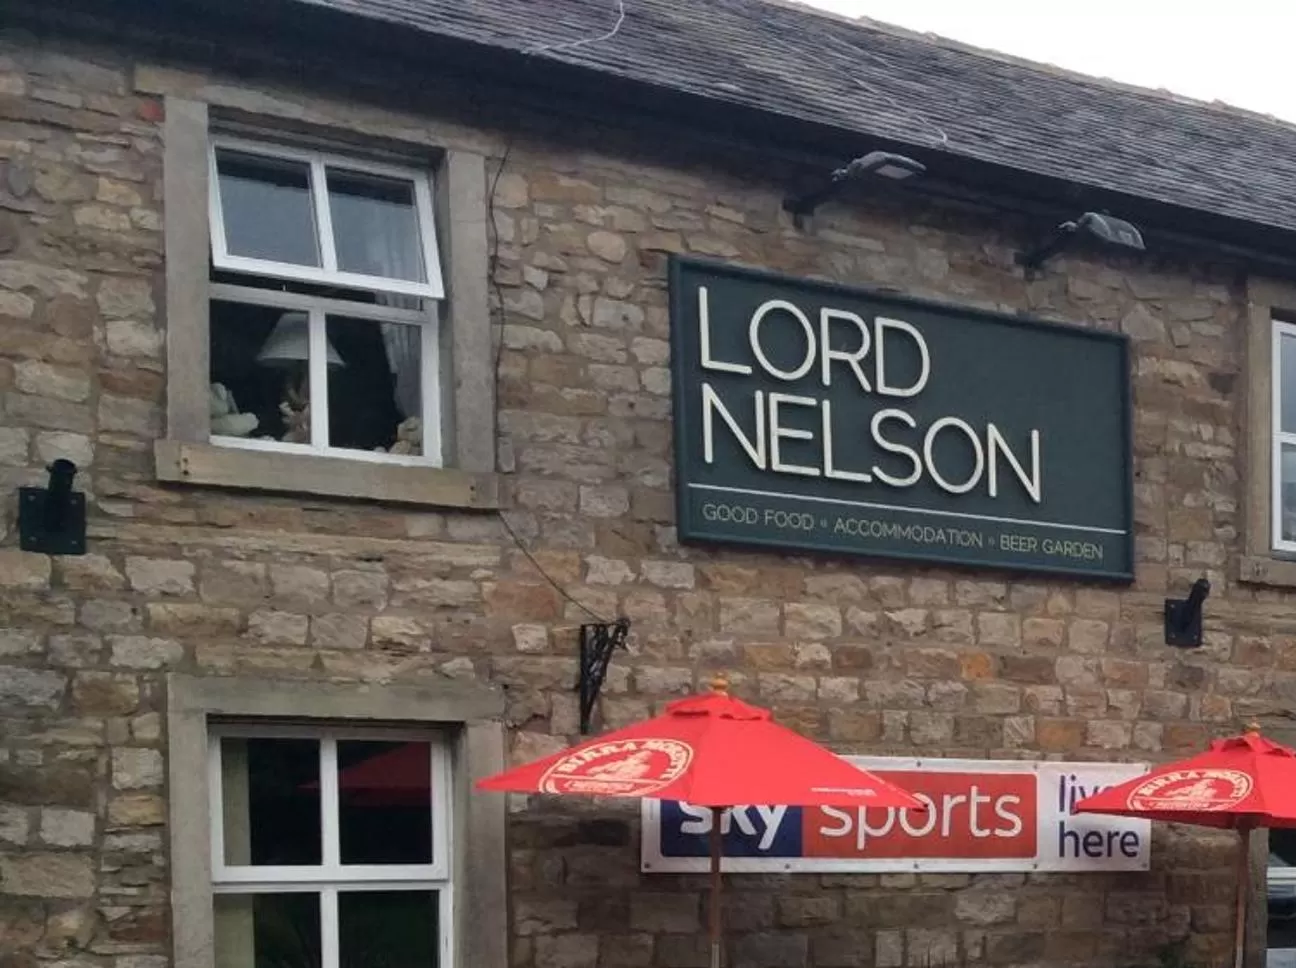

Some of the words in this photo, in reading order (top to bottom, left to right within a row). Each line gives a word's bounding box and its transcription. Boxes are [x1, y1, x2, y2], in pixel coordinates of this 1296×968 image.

[698, 286, 931, 398] LORD
[701, 382, 1042, 503] NELSON
[702, 503, 759, 525] GOOD
[764, 509, 815, 531] FOOD
[833, 518, 984, 549] ACCOMMODATION
[1000, 533, 1039, 552] BEER
[1042, 539, 1104, 560] GARDEN
[678, 800, 789, 850] sky
[818, 785, 1023, 850] sports
[1058, 774, 1114, 814] liv
[1058, 820, 1140, 859] here
